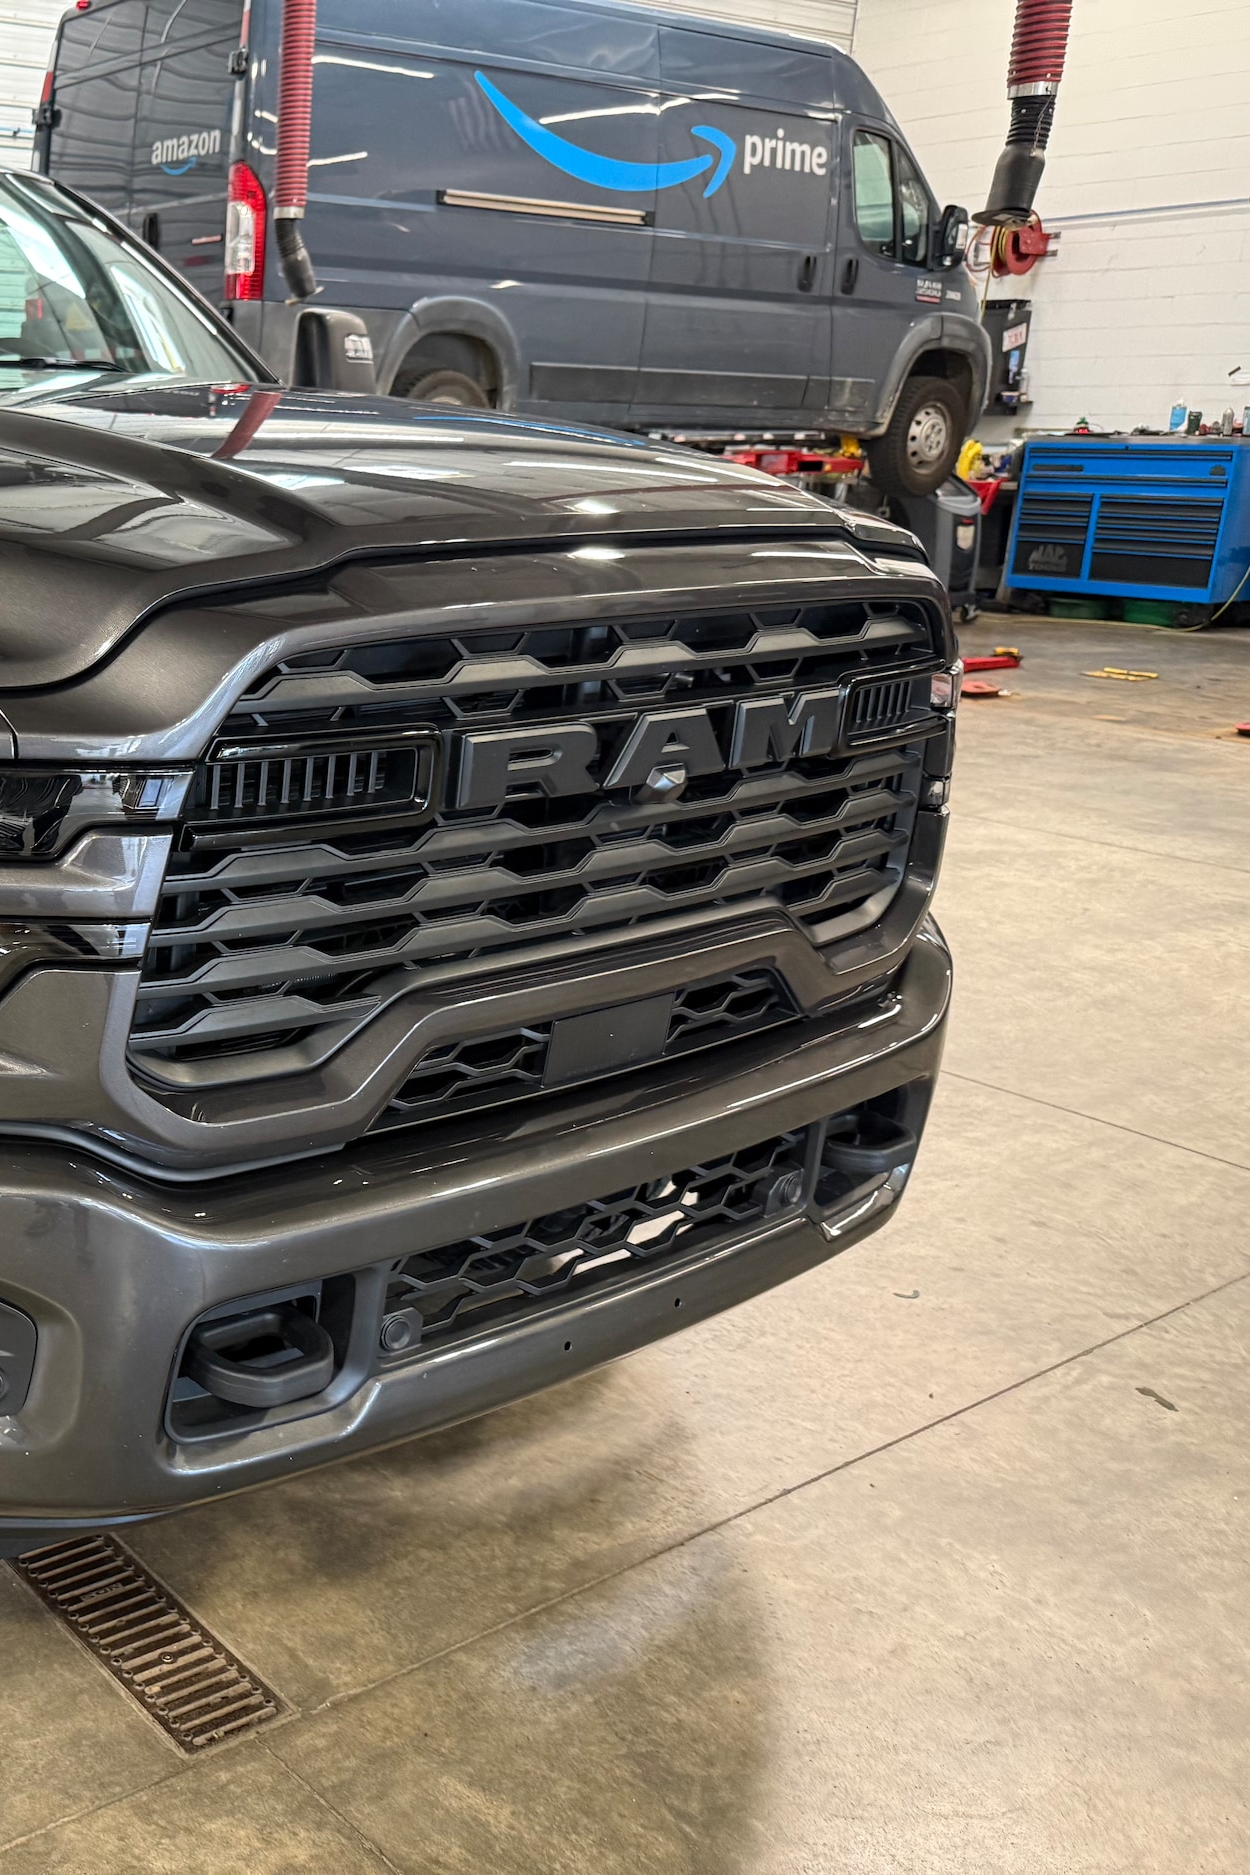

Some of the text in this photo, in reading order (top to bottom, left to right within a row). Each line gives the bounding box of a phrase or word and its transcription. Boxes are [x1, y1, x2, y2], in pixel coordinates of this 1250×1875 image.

[151, 129, 221, 165] amazon
[743, 128, 828, 176] prime
[456, 688, 841, 809] RAM
